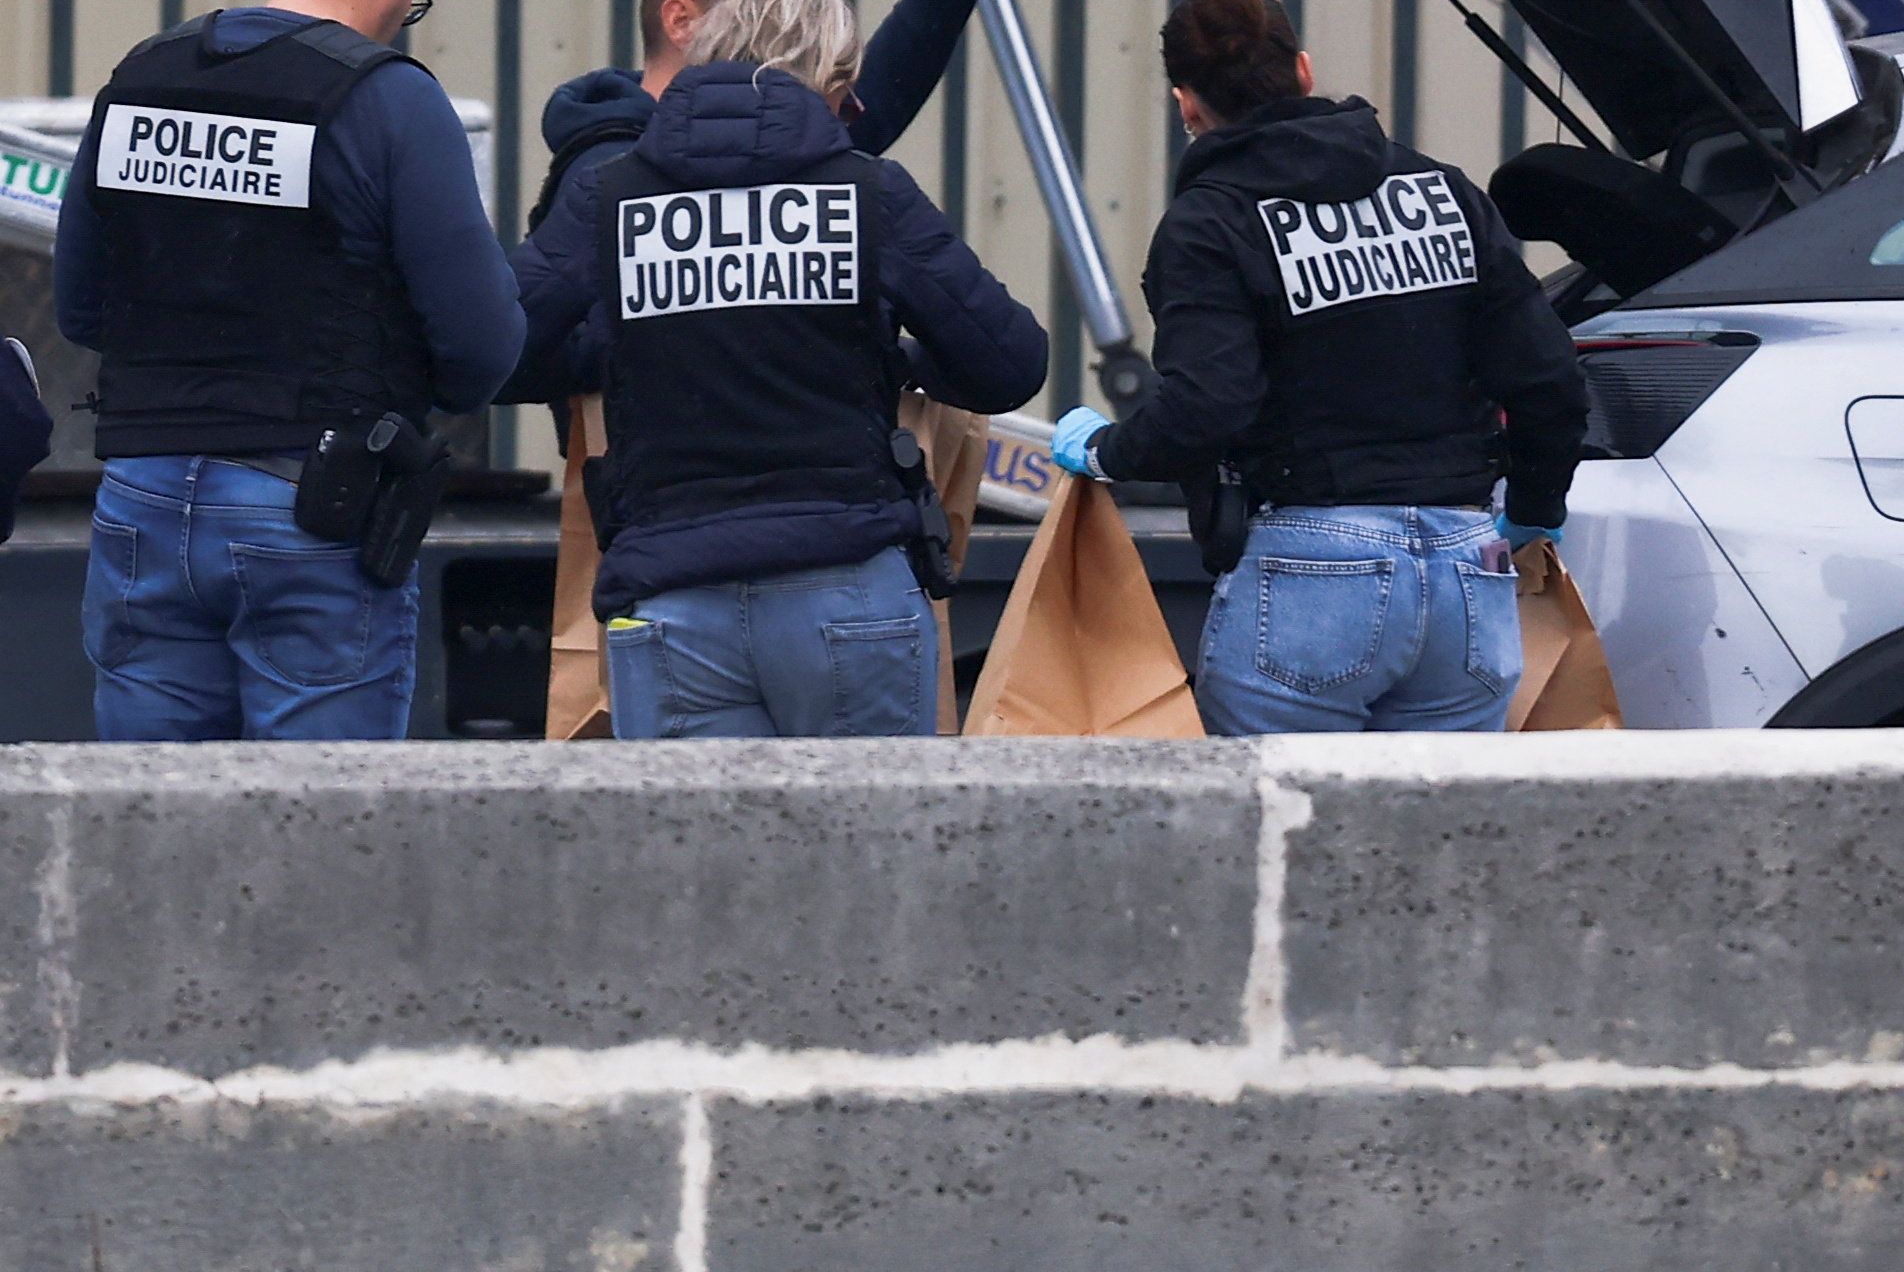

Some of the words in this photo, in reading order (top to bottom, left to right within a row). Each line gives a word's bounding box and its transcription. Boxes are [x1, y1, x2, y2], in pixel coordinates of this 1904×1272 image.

[128, 116, 277, 166] POLICE
[2, 153, 70, 200] TU
[118, 158, 282, 197] JUDICIAIRE
[623, 187, 853, 258] POLICE
[1263, 175, 1462, 256] POLICE
[626, 251, 853, 313] JUDICIAIRE
[1292, 230, 1474, 309] JUDICIAIRE
[983, 439, 1052, 492] US
